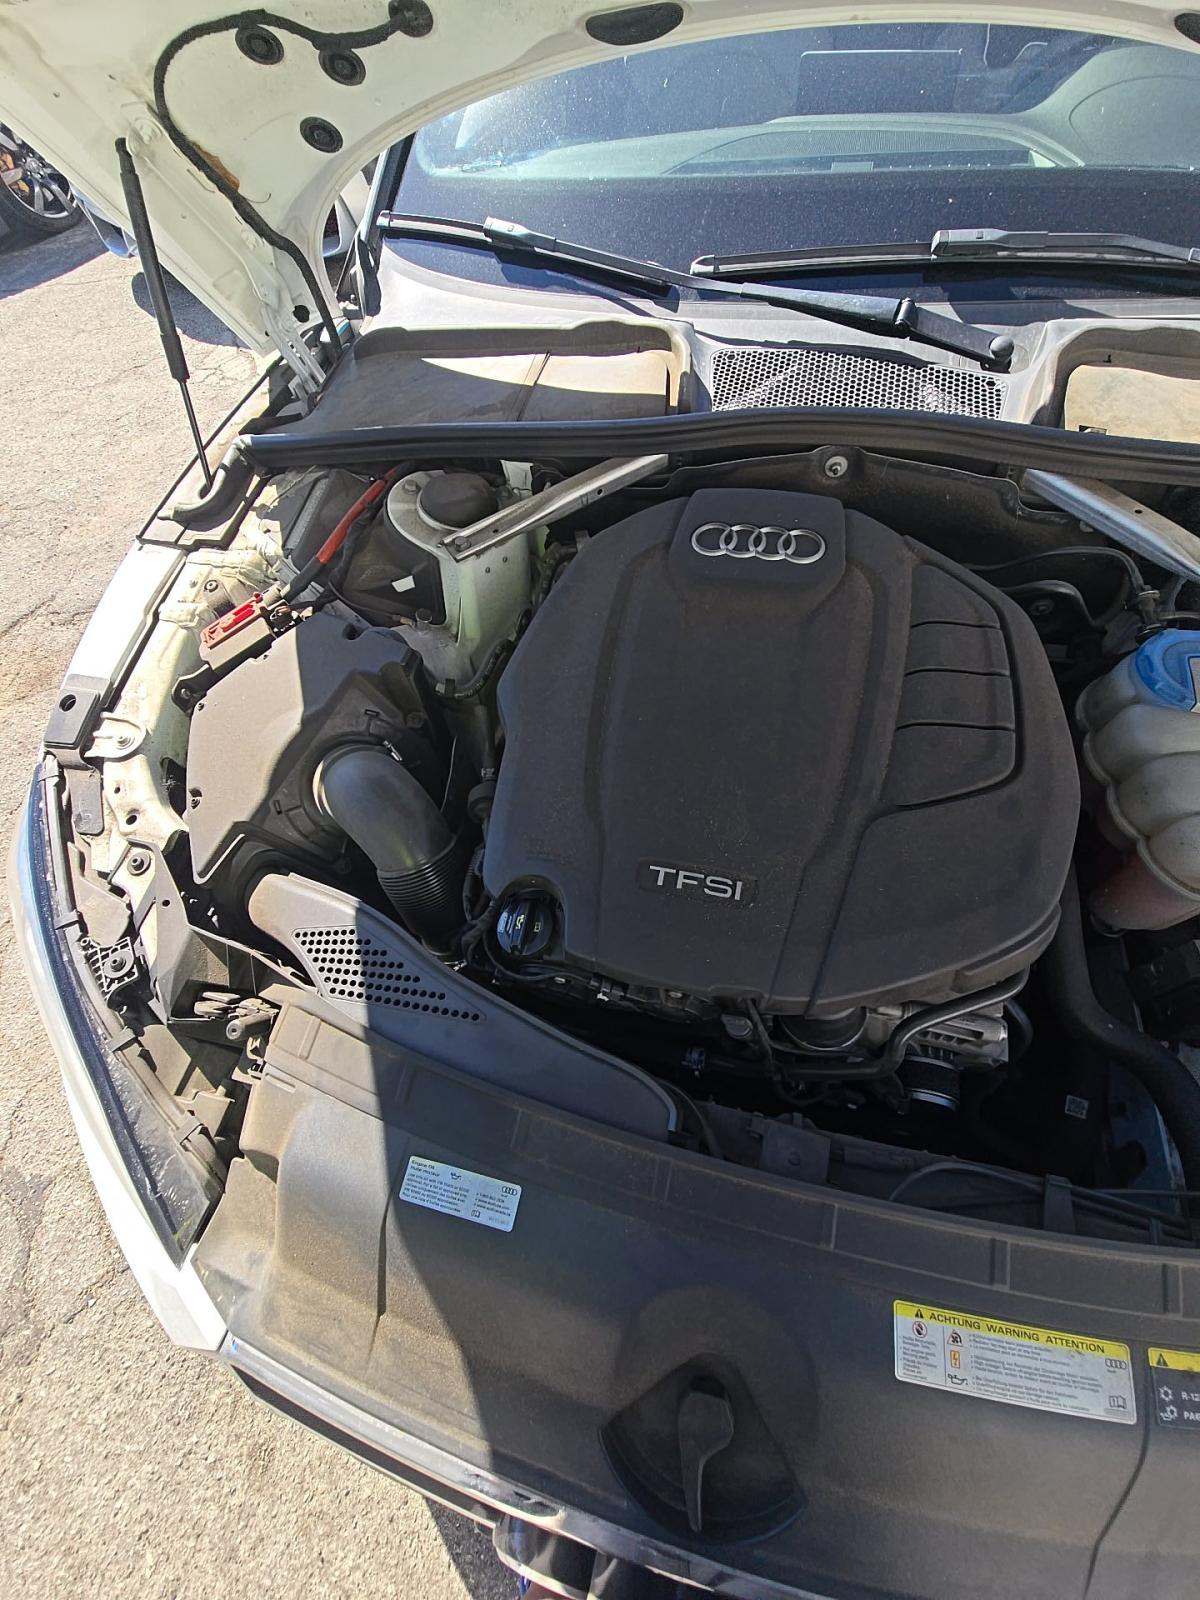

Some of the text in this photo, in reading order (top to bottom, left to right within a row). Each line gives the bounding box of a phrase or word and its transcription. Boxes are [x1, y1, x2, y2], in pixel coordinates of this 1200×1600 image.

[649, 865, 743, 901] TFSI
[929, 1312, 981, 1330] ACHTUNG
[985, 1323, 1040, 1342] WARNING
[1045, 1335, 1105, 1354] ATTENTION
